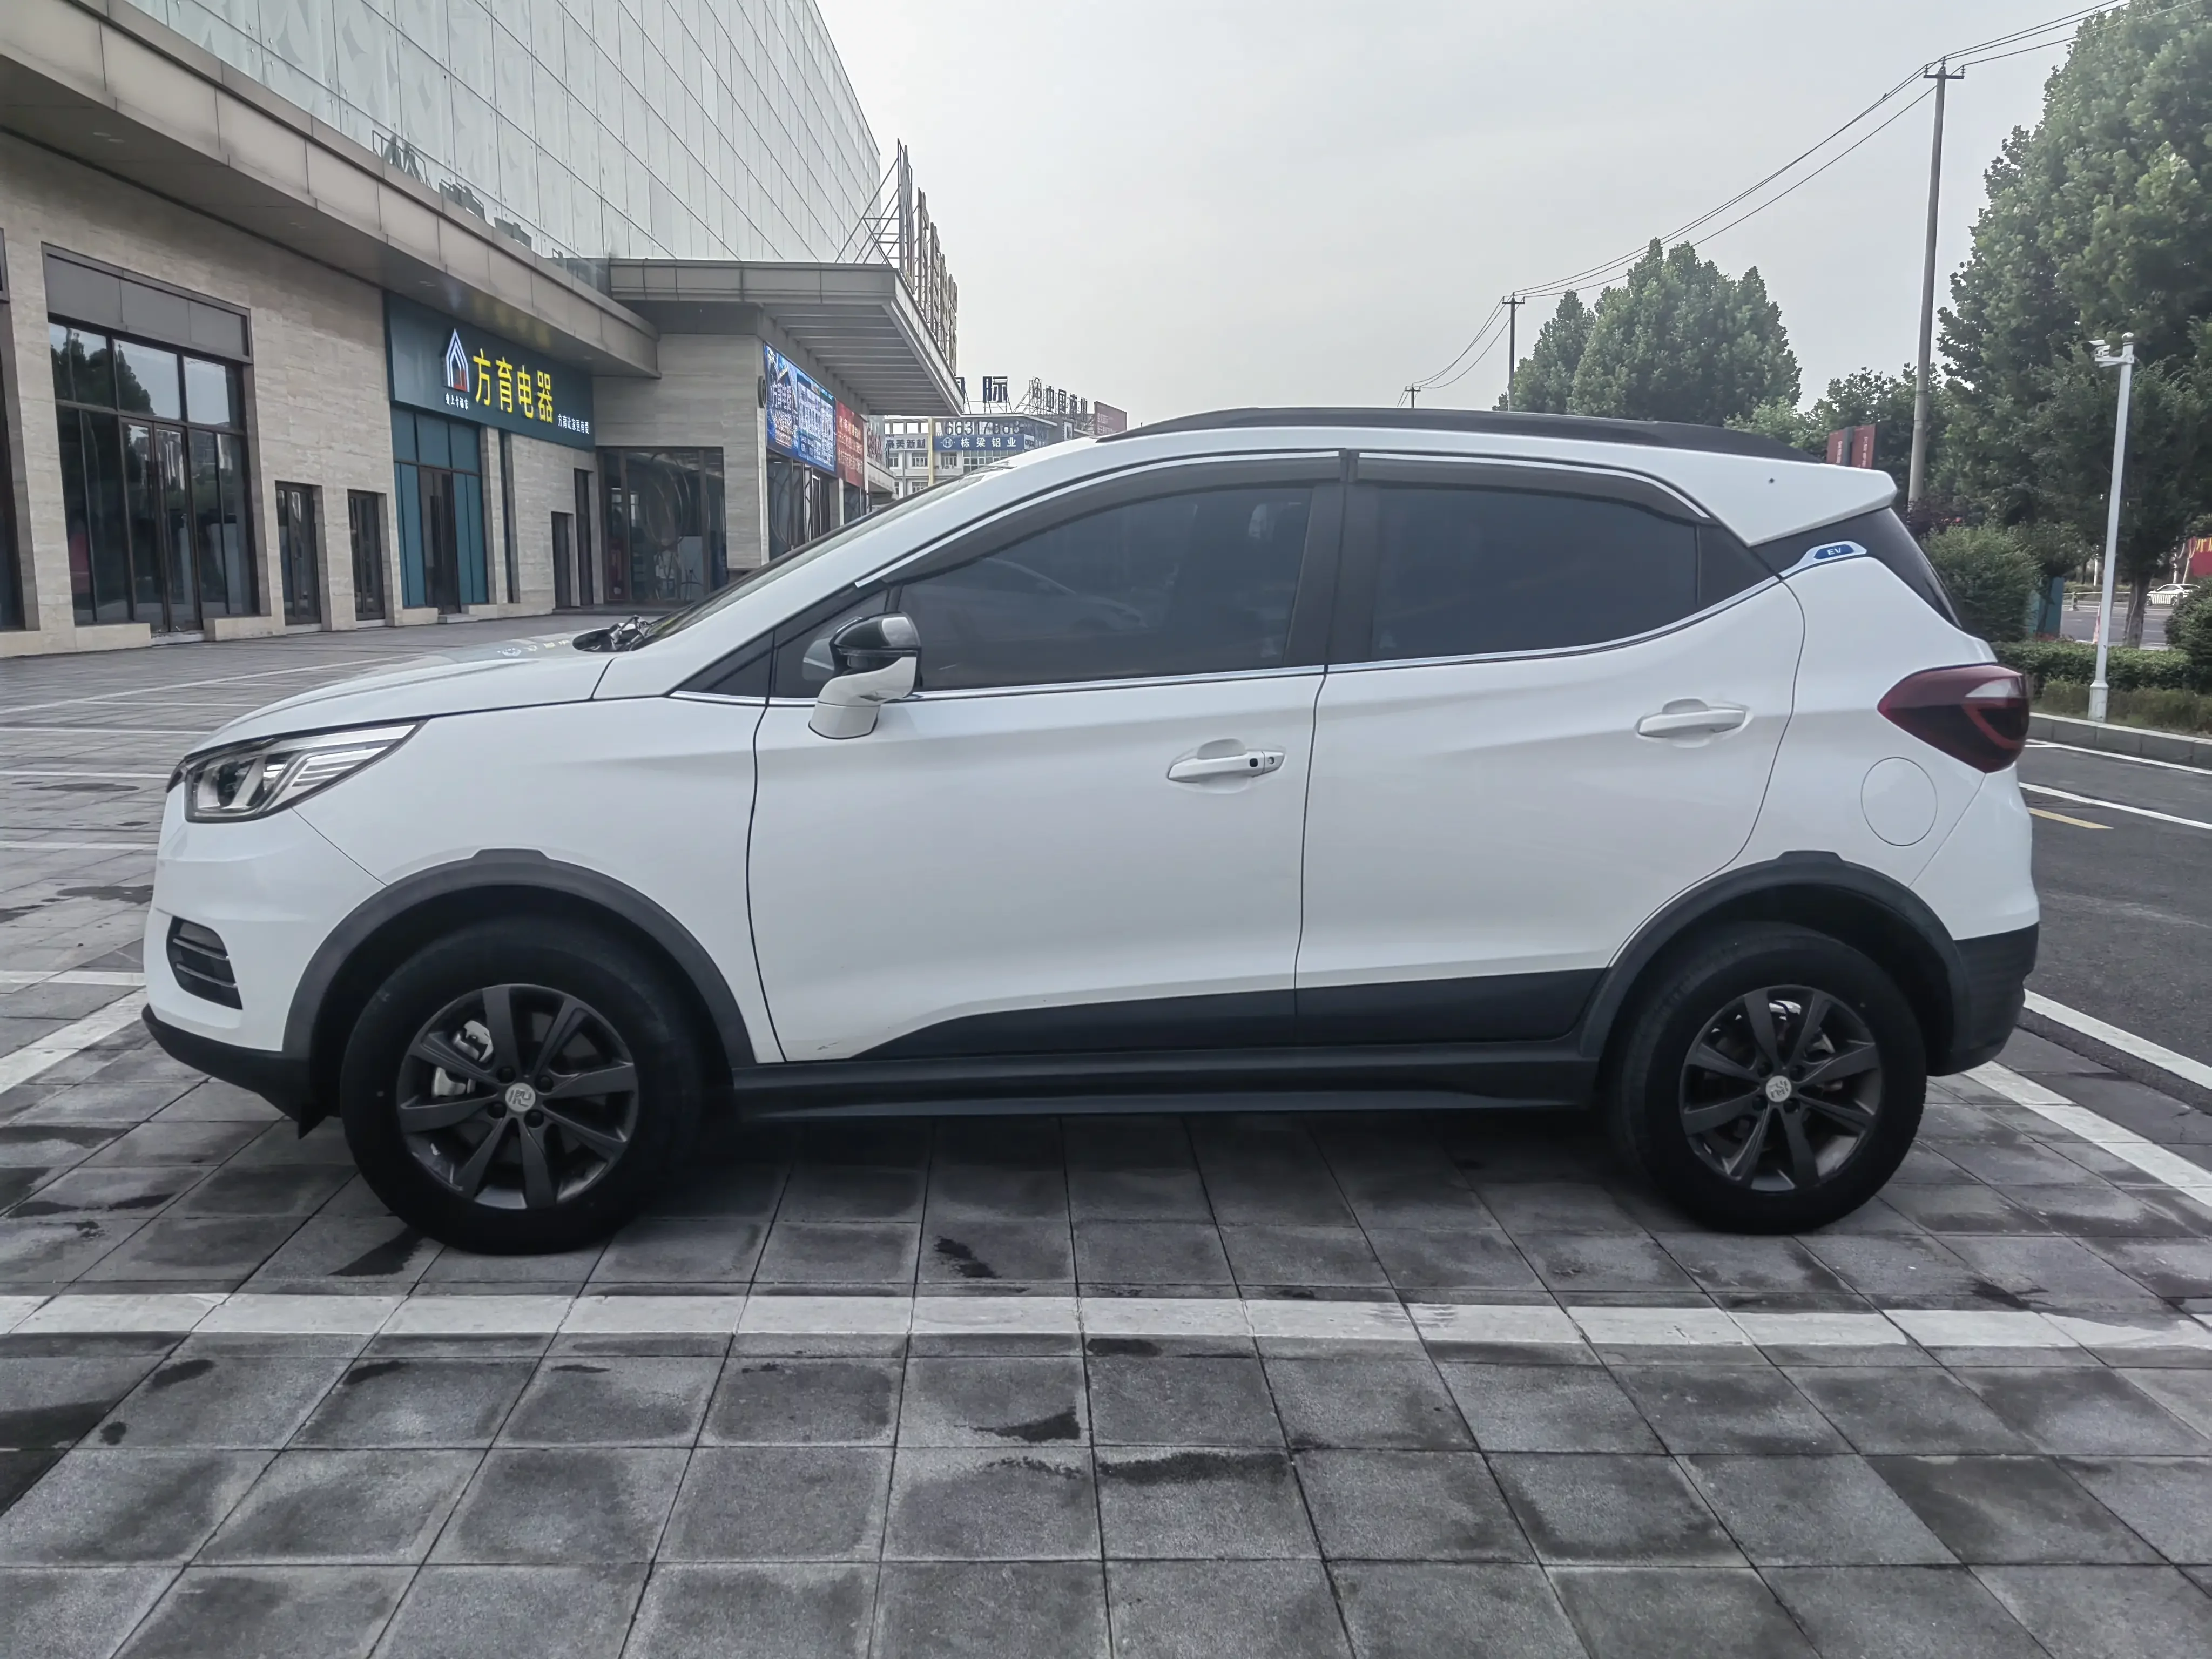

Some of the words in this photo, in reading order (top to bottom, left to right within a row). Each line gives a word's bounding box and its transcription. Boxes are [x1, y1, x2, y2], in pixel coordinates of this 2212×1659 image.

[473, 348, 553, 423] 方育电器
[557, 414, 589, 434] 方育让家更有爱
[960, 437, 1016, 448] 栋梁铝业
[1827, 547, 1842, 555] EV
